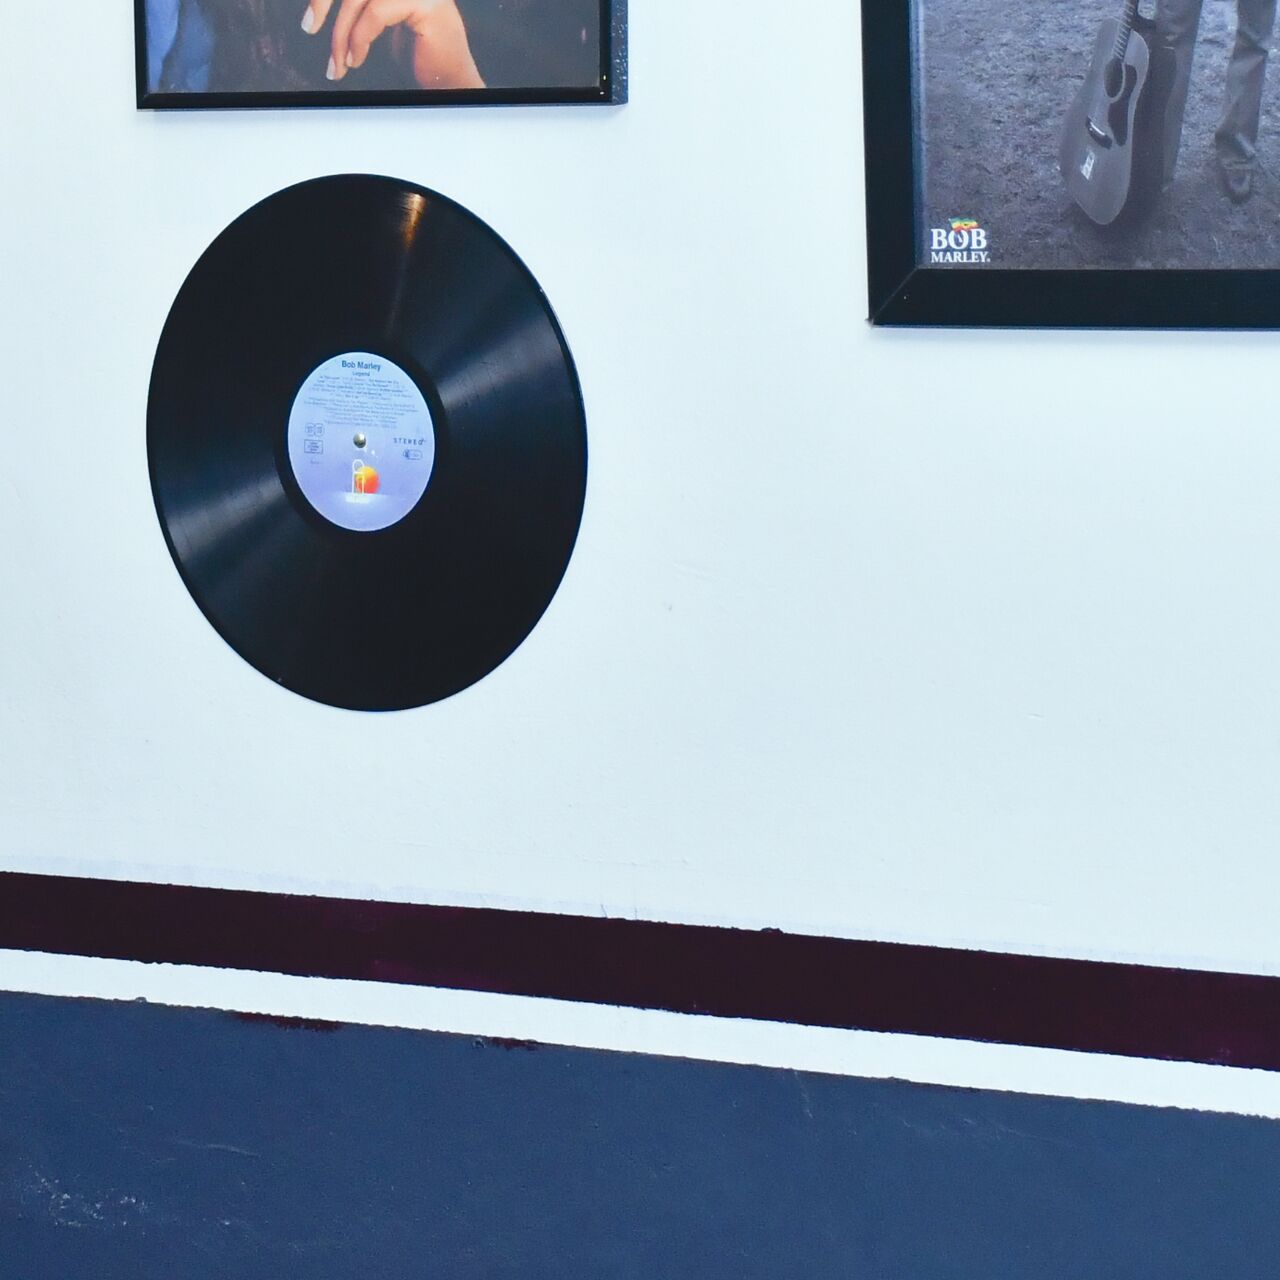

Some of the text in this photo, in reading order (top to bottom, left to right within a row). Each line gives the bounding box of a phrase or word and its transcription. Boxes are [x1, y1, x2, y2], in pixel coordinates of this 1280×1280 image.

[930, 228, 987, 250] BOB
[341, 360, 381, 372] Bob Marley
